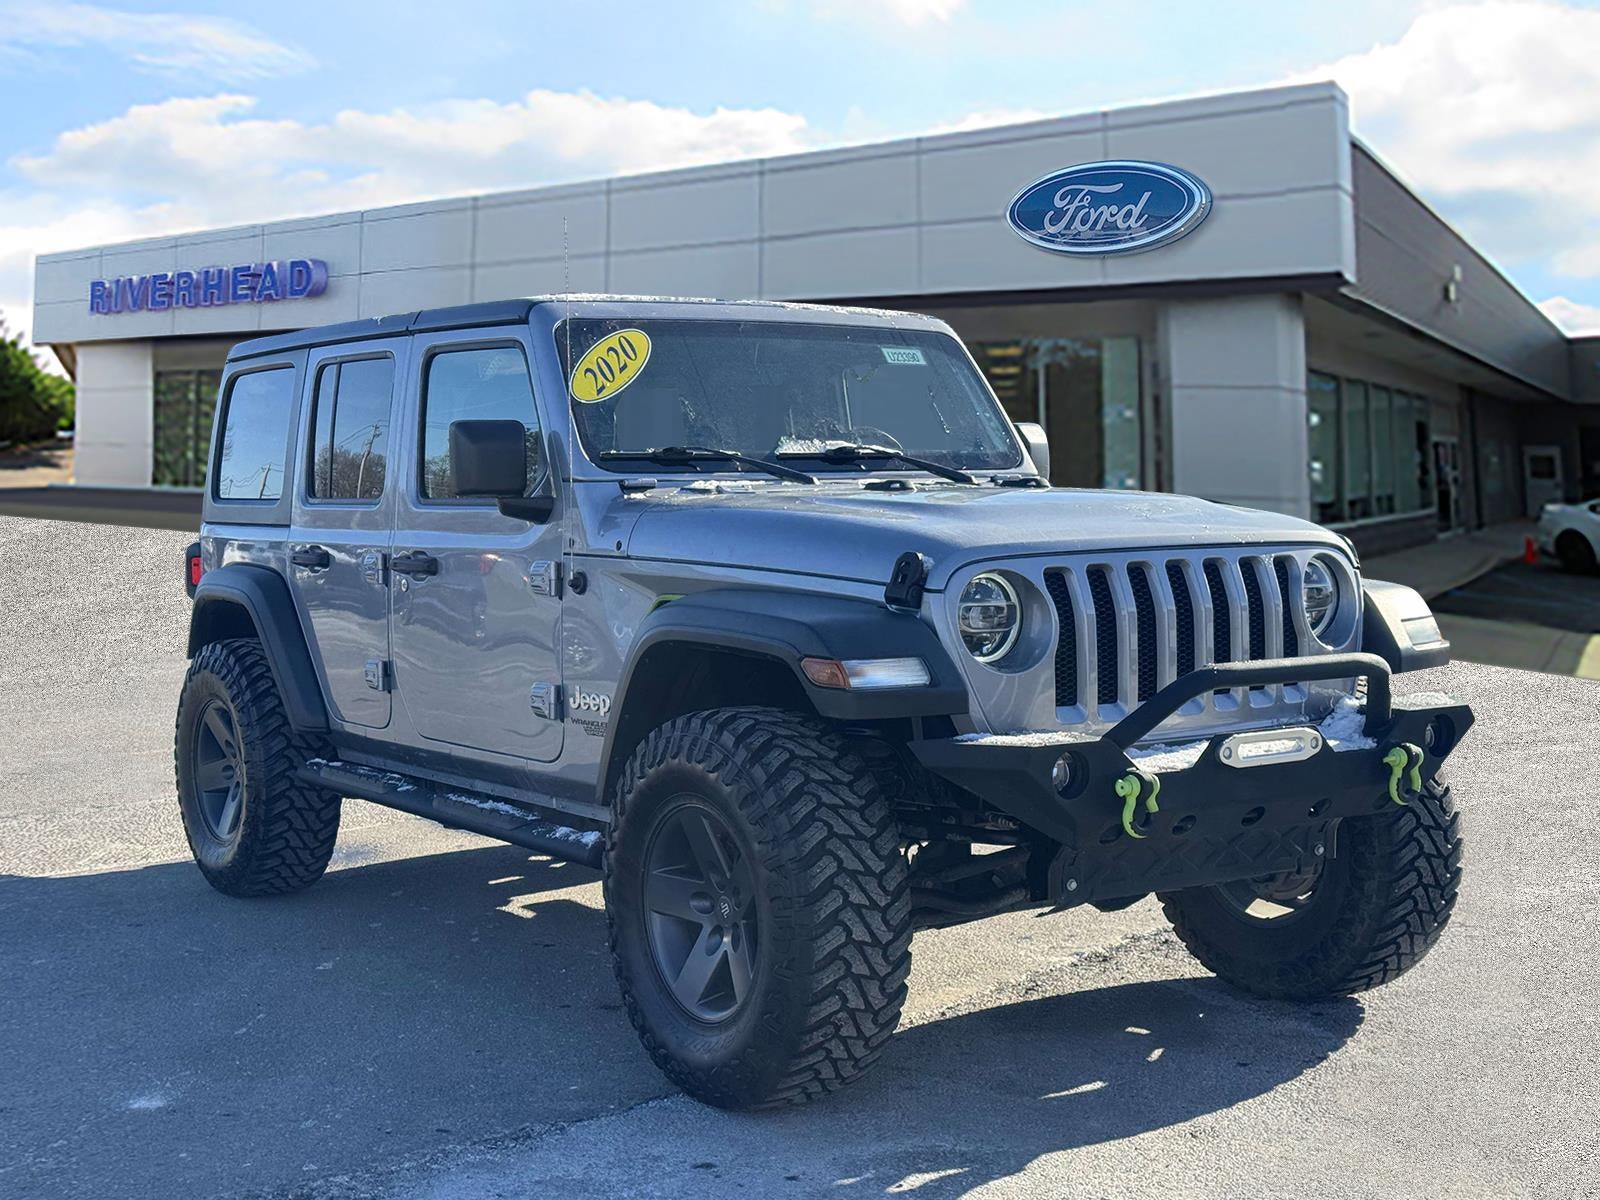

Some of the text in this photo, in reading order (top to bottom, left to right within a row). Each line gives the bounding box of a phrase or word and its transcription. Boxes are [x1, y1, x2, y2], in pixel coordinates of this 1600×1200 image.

[1044, 182, 1152, 233] Ford
[89, 259, 327, 314] RIVERHEAD
[584, 335, 637, 396] 2020
[569, 685, 611, 717] Jeep
